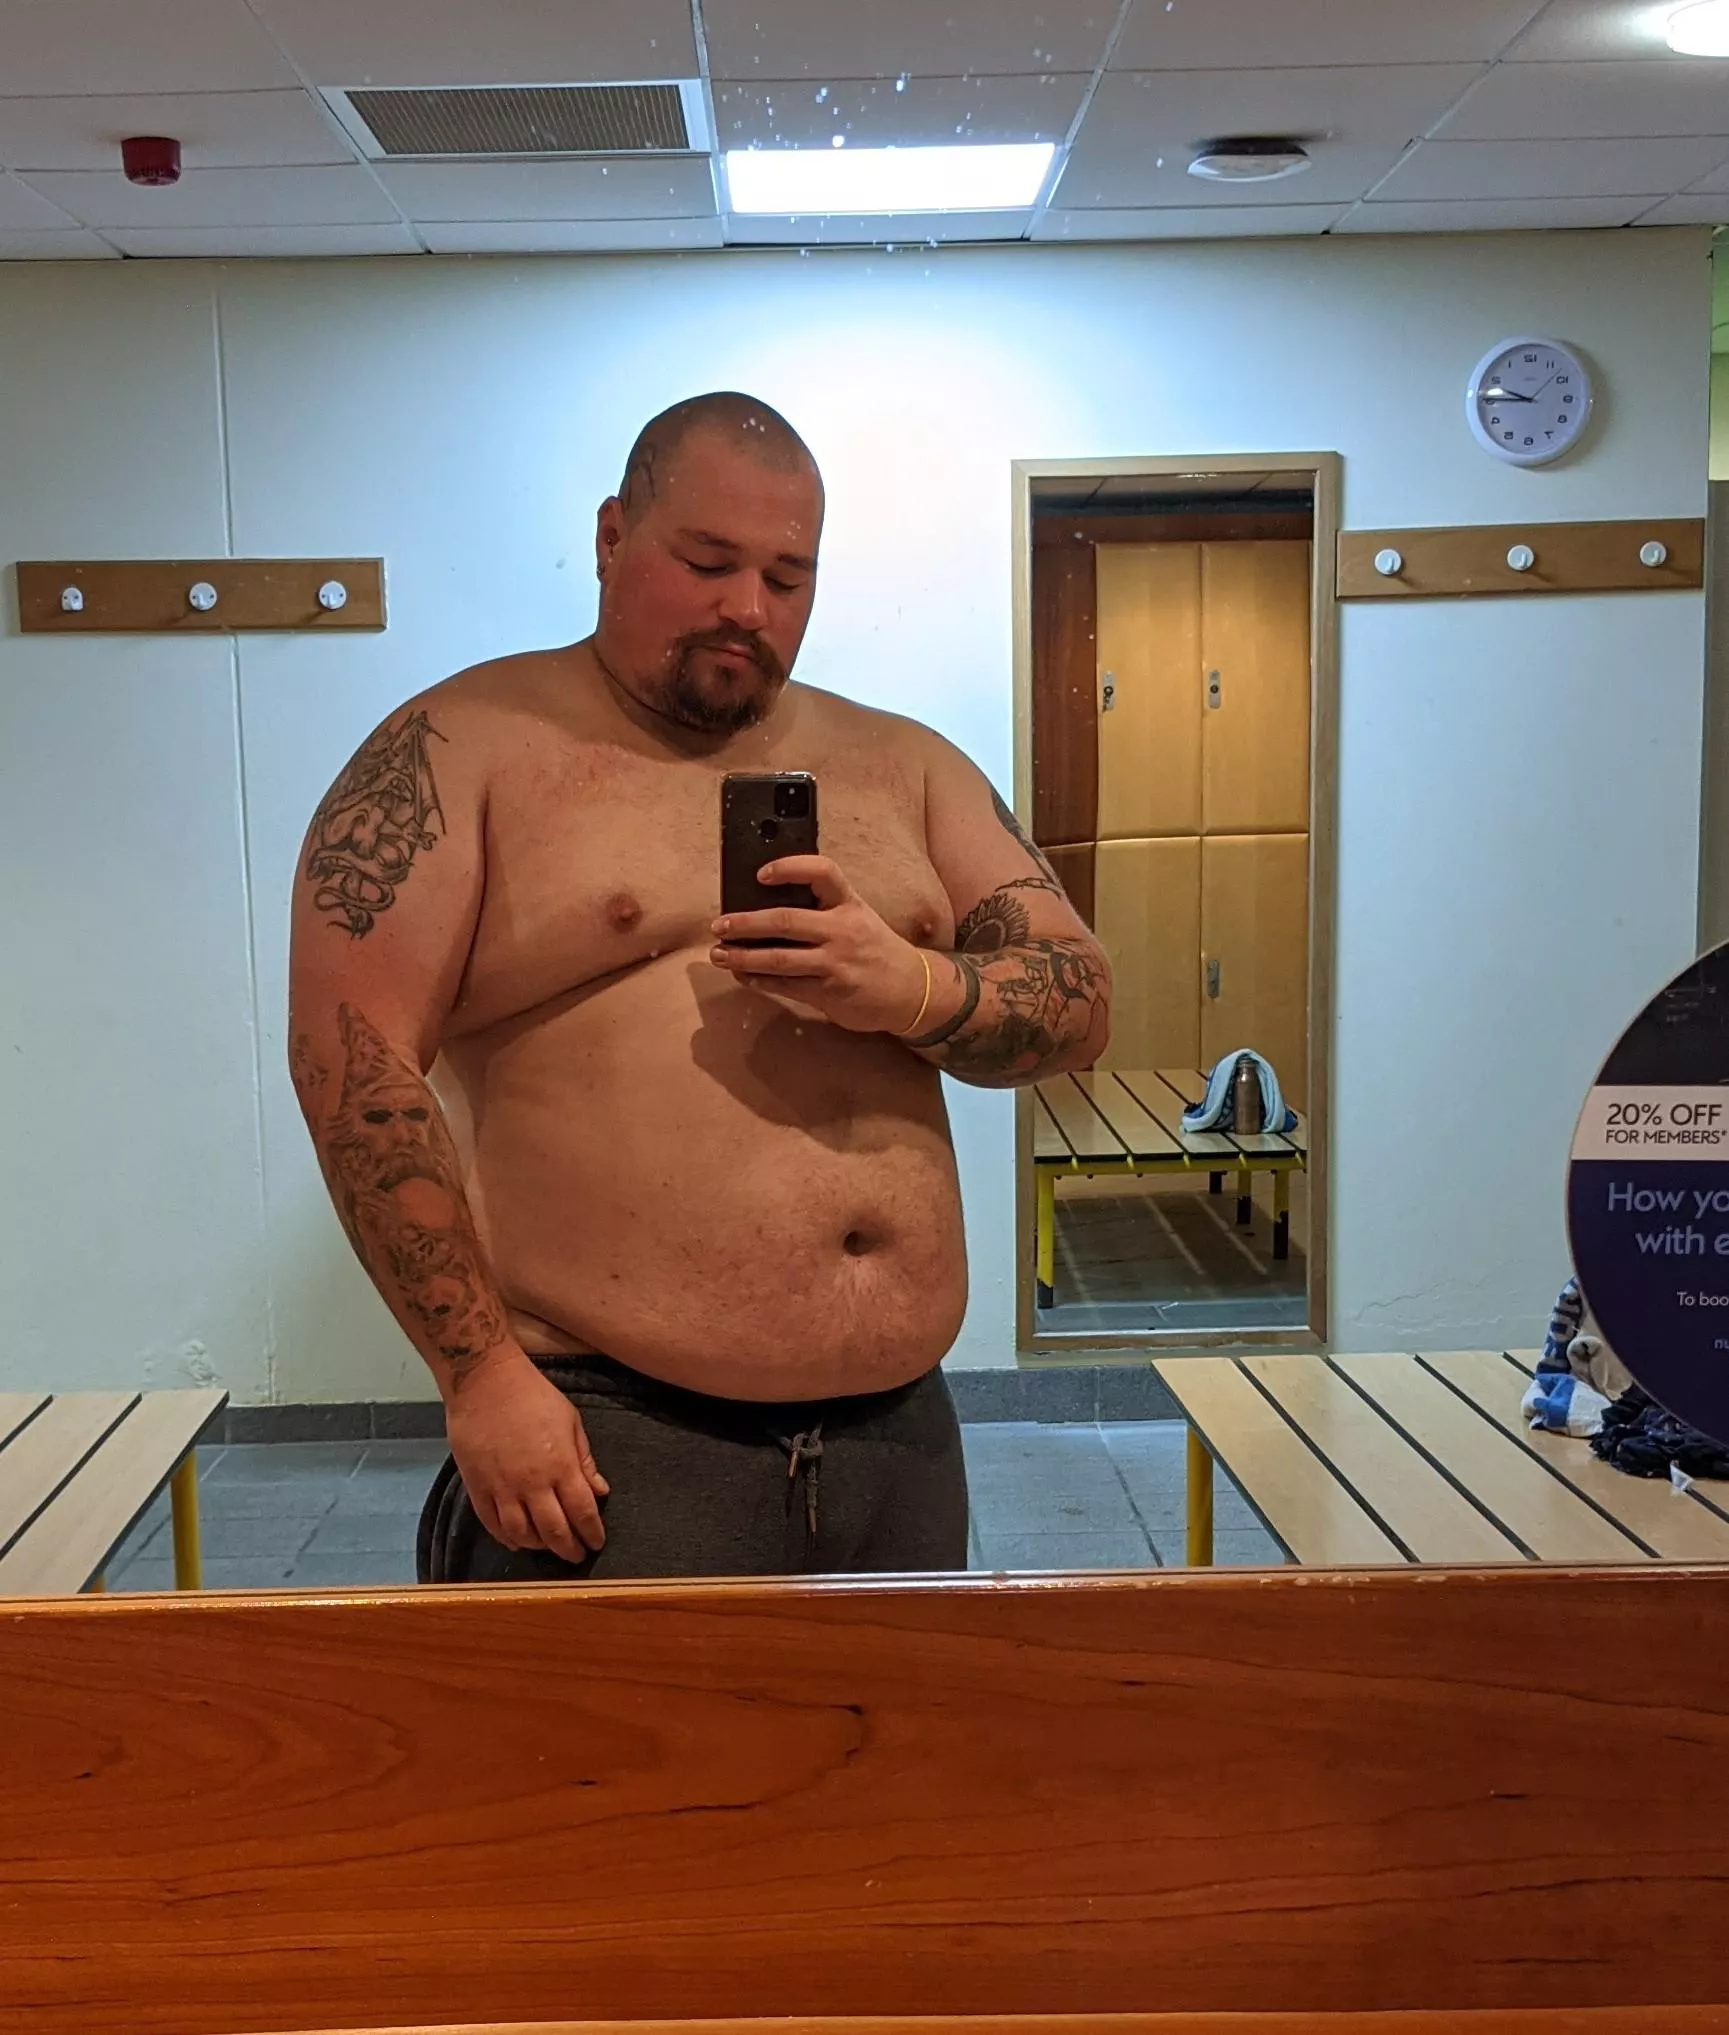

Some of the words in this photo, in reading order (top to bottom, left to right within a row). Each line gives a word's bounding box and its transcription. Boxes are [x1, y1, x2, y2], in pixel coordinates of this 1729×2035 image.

[1606, 1103, 1663, 1126] 20%
[1670, 1103, 1723, 1126] OFF
[1605, 1129, 1641, 1144] FOR
[1607, 1182, 1686, 1212] How
[1634, 1224, 1706, 1255] with
[1676, 1291, 1698, 1306] To
[1699, 1291, 1729, 1307] boo
